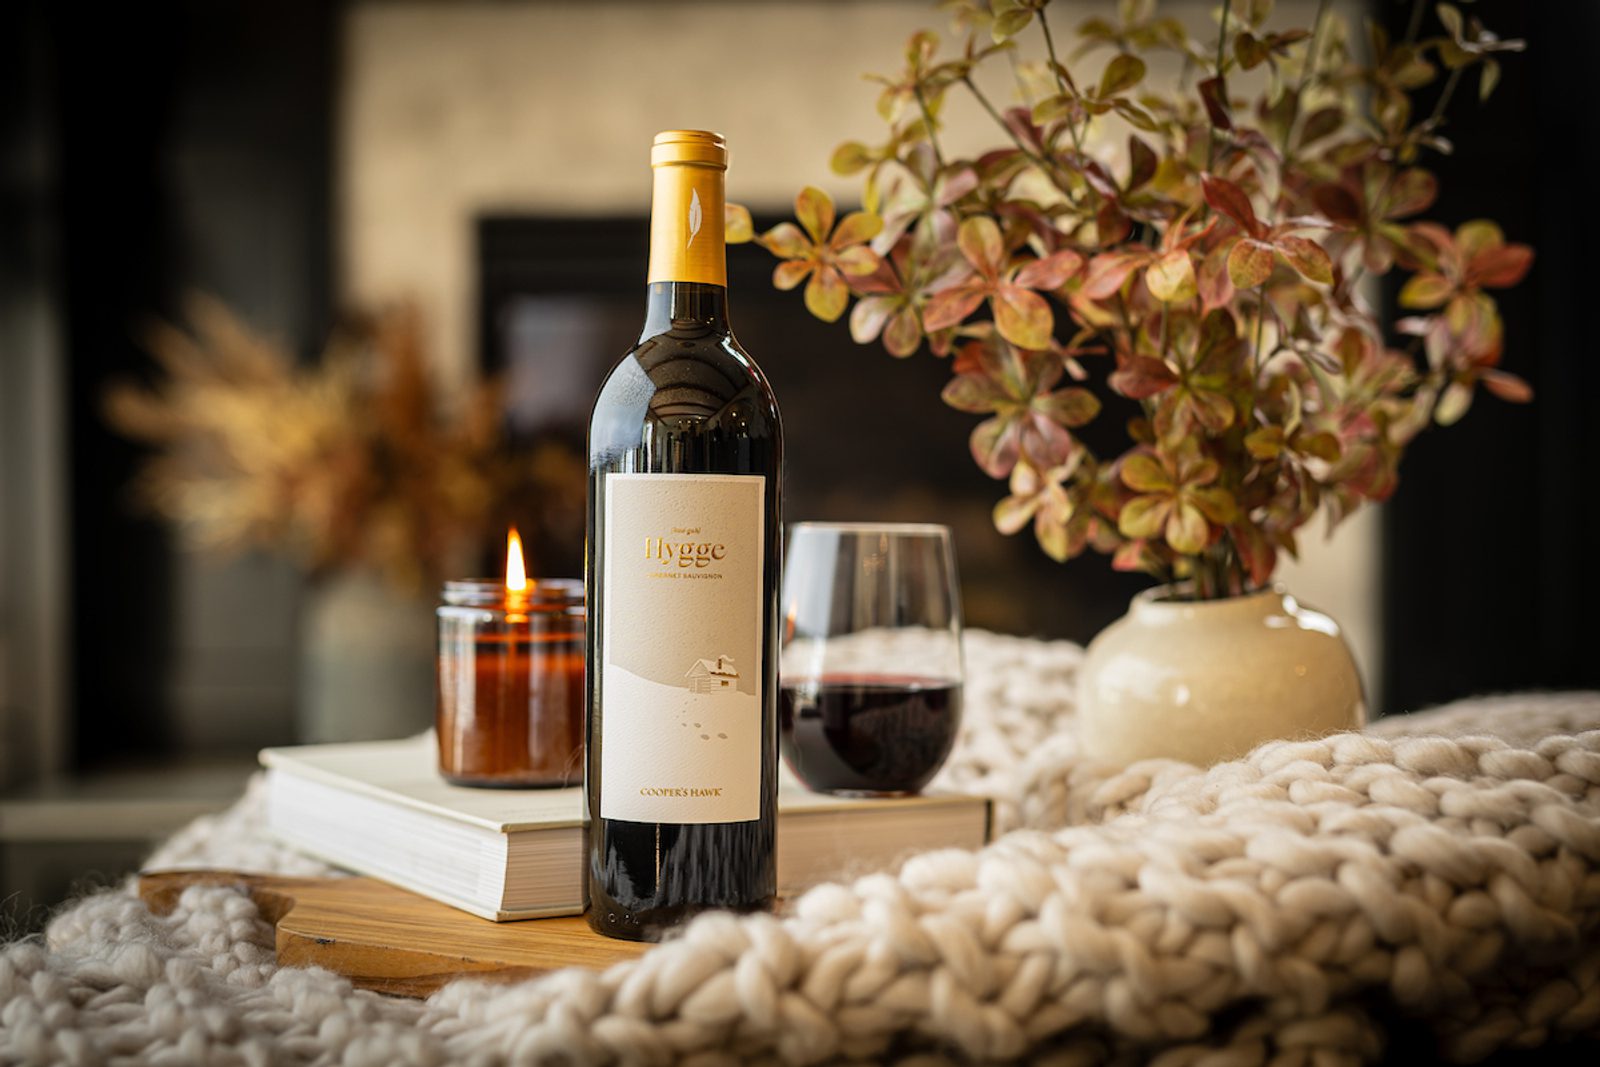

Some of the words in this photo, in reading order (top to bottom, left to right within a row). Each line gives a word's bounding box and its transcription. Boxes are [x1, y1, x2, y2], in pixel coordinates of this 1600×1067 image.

[645, 536, 727, 568] Hygge
[683, 572, 723, 580] SAUVIGNON
[639, 787, 688, 797] COOPER'S
[690, 787, 721, 797] HAWK
